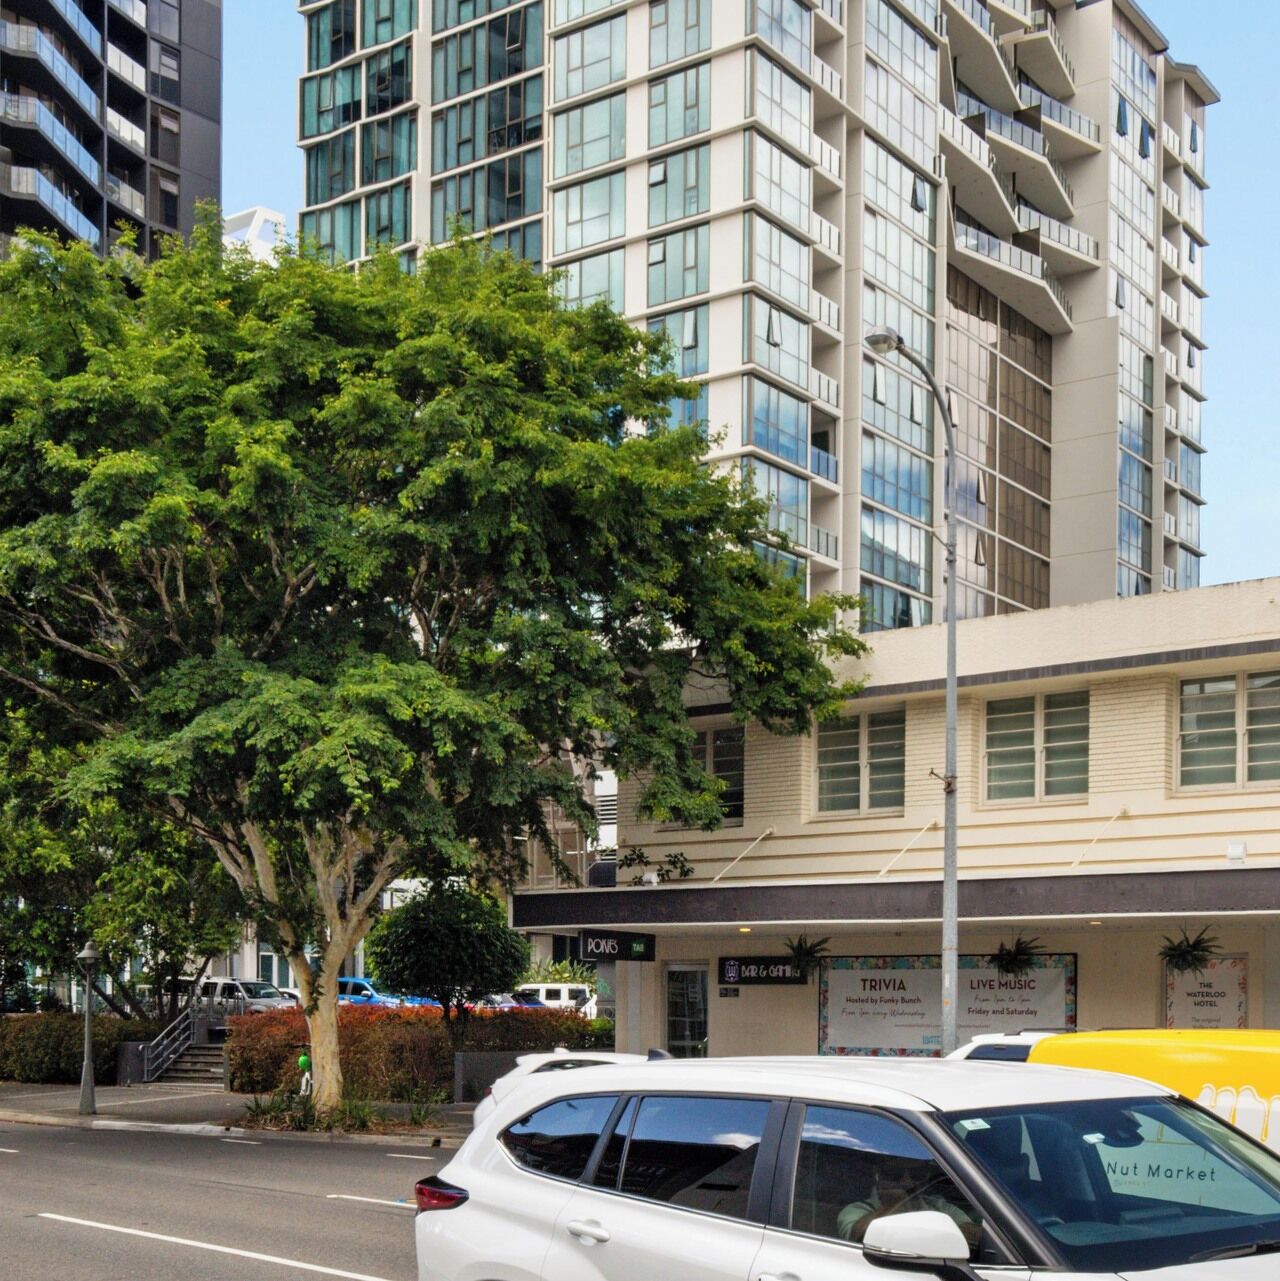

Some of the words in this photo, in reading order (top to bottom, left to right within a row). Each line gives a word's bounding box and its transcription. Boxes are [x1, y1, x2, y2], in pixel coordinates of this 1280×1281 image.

[587, 938, 619, 954] POKIES
[632, 943, 645, 952] TAB
[741, 965, 758, 977] BAR
[759, 965, 768, 977] &
[860, 978, 906, 992] TRIVIA
[970, 980, 995, 990] LIVE
[998, 979, 1037, 990] MUSIC
[846, 996, 869, 1004] Hosted
[870, 996, 878, 1005] by
[879, 996, 899, 1005] Funky
[901, 996, 922, 1004] Bunch
[968, 1007, 990, 1017] Friday
[992, 1007, 1004, 1015] and
[1006, 1007, 1038, 1017] Saturday
[1106, 1161, 1139, 1177] Nut
[1147, 1163, 1217, 1182] Market
